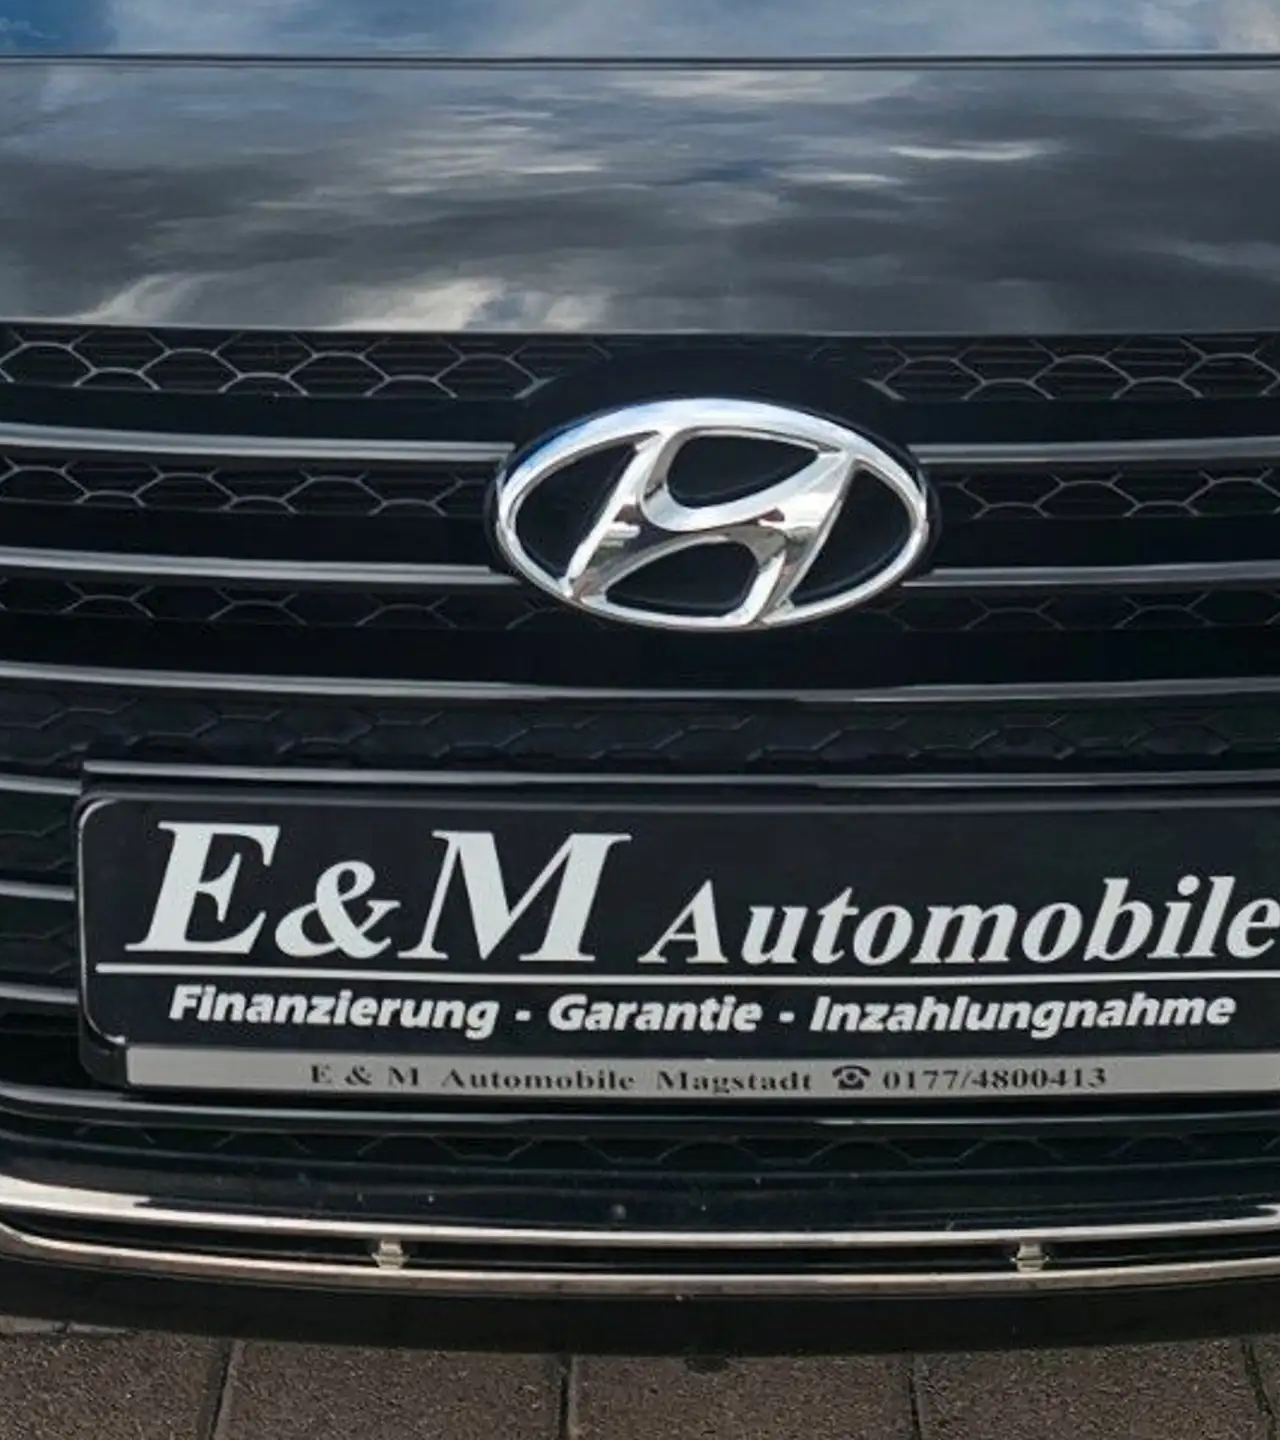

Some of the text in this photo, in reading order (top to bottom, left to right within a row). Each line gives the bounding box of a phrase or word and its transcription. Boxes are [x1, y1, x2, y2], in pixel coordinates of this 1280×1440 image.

[124, 820, 631, 963] E&M
[168, 984, 500, 1040] Finanzierung
[548, 994, 764, 1032] Garantie
[810, 991, 1237, 1039] Inzahlungnahme
[441, 1067, 636, 1091] Automobile
[656, 1069, 813, 1095] Magstadt
[882, 1067, 1108, 1090] 0177/4800413
